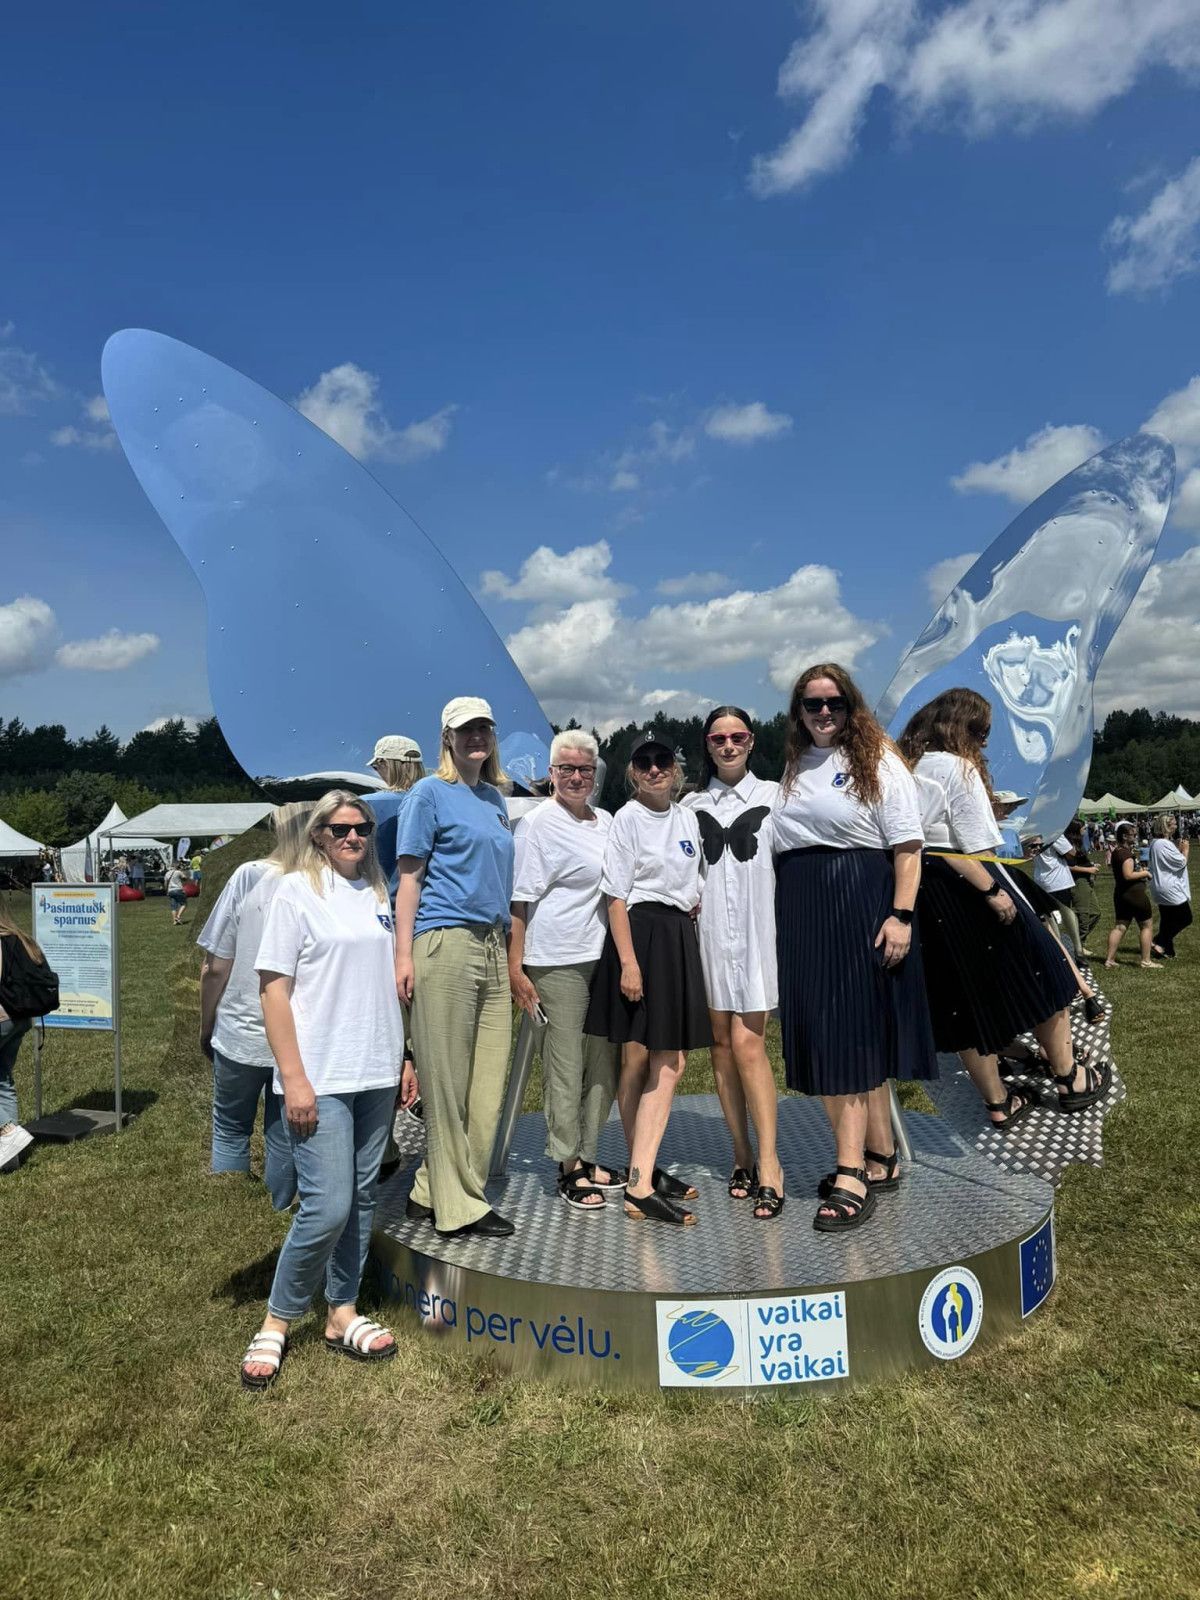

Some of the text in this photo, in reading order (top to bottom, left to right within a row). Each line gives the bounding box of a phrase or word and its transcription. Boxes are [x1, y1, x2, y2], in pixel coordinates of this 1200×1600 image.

[54, 915, 97, 928] sparnus
[757, 1294, 843, 1326] vaikai
[466, 1306, 522, 1343] per
[529, 1315, 621, 1360] vėlu.
[759, 1332, 803, 1360] yra
[760, 1350, 846, 1382] vaikai
